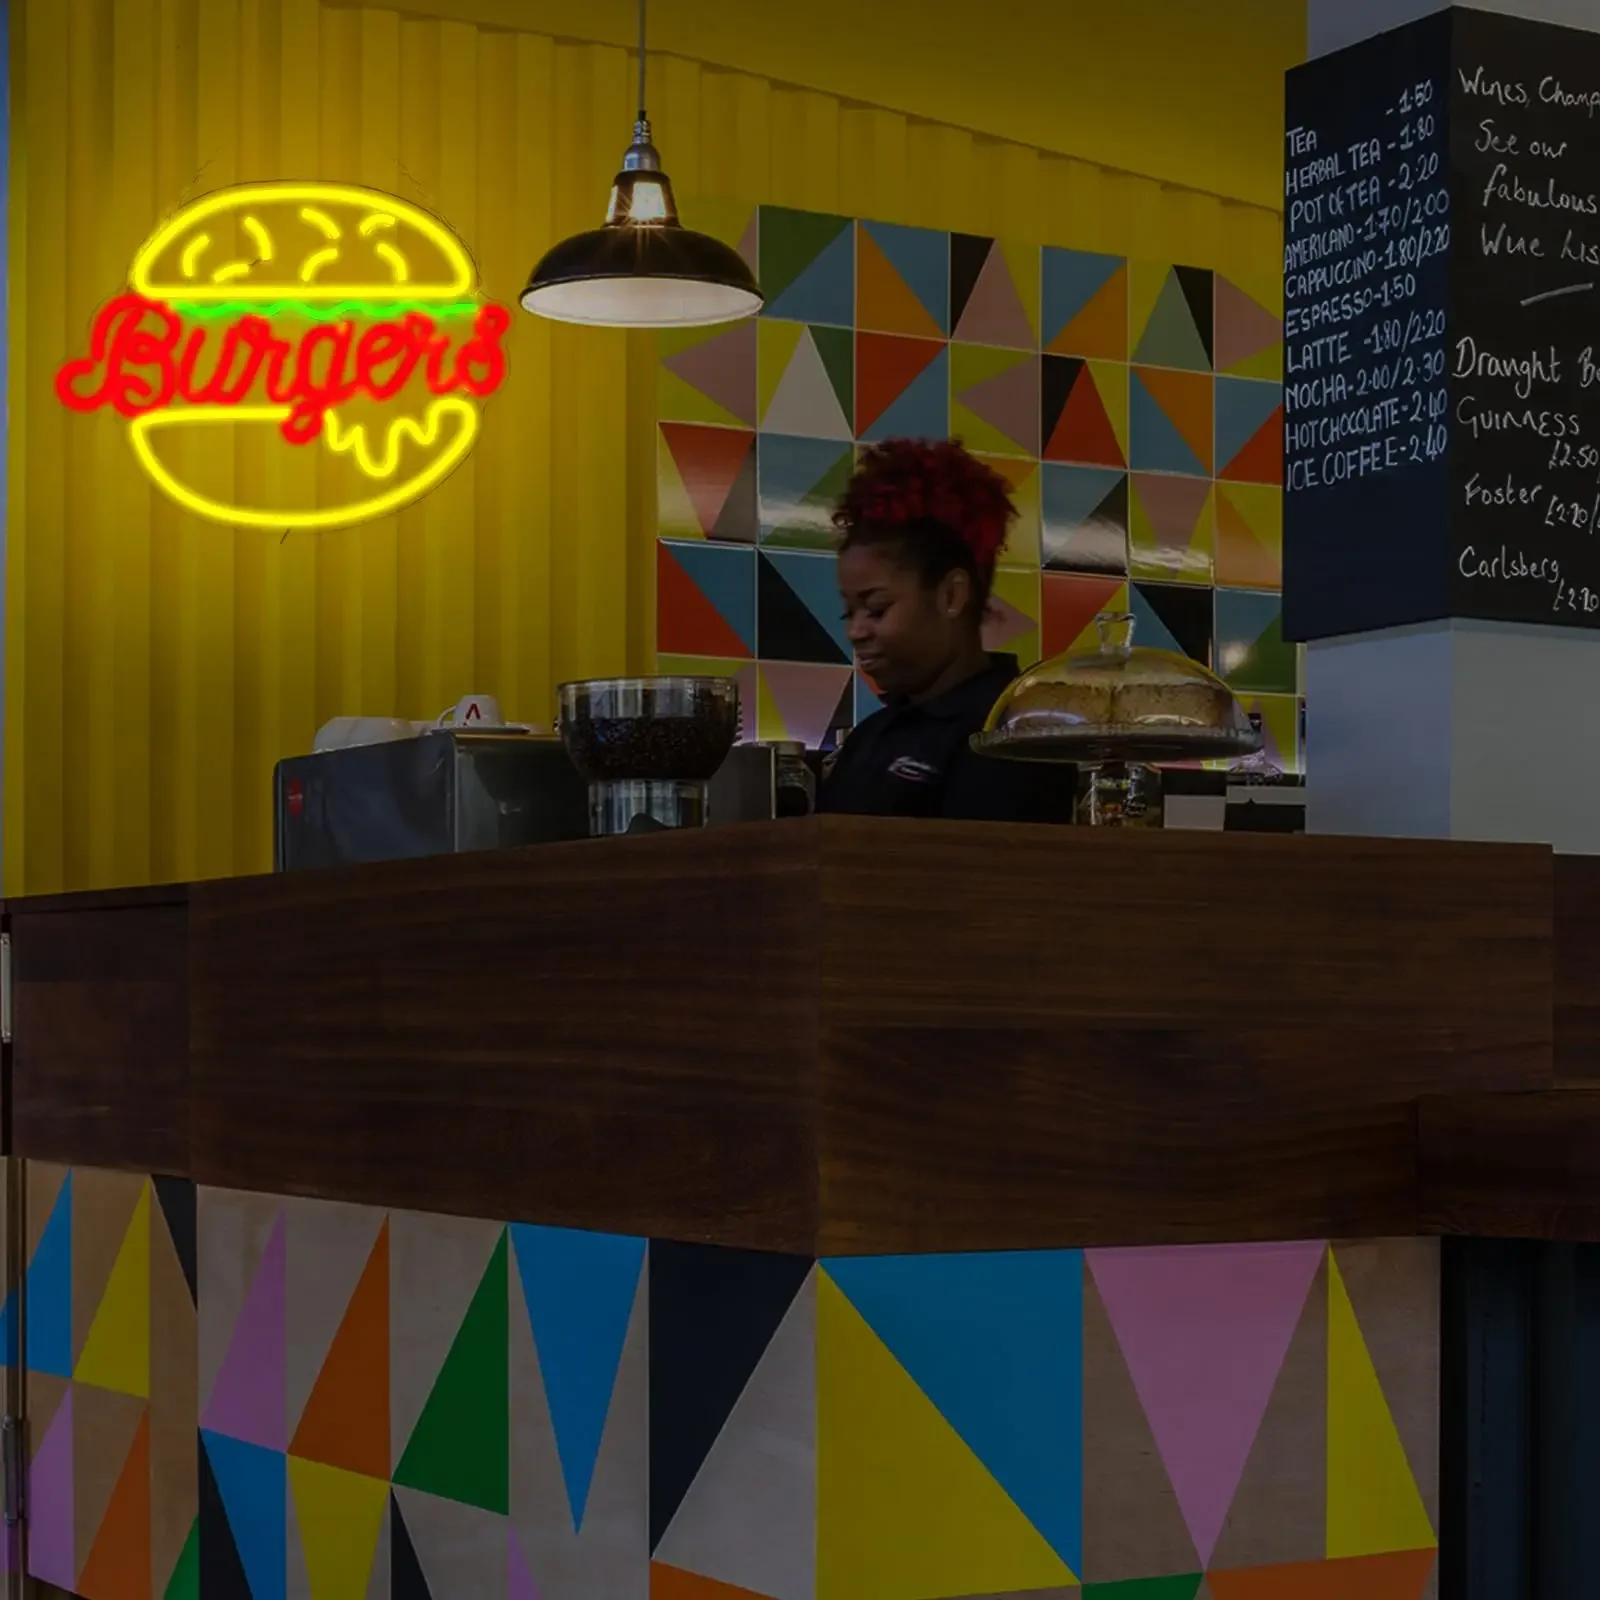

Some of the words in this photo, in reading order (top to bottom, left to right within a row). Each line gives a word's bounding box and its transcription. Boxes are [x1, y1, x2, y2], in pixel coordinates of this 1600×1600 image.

[1285, 126, 1317, 157] TEA
[1475, 118, 1519, 155] See
[1529, 141, 1568, 159] our
[1285, 152, 1346, 197] HERBAL
[1348, 137, 1381, 171] TEA
[1482, 162, 1598, 214] fabulous
[1291, 193, 1325, 232] POT
[1345, 175, 1381, 211] TEA
[1481, 222, 1545, 257] Wine
[55, 292, 512, 445] Burgers
[1287, 330, 1352, 374] LATTE
[1452, 336, 1561, 399] Draught
[1286, 457, 1319, 493] ICE
[1464, 472, 1543, 505] Foster
[1459, 545, 1560, 583] Carlsberg
